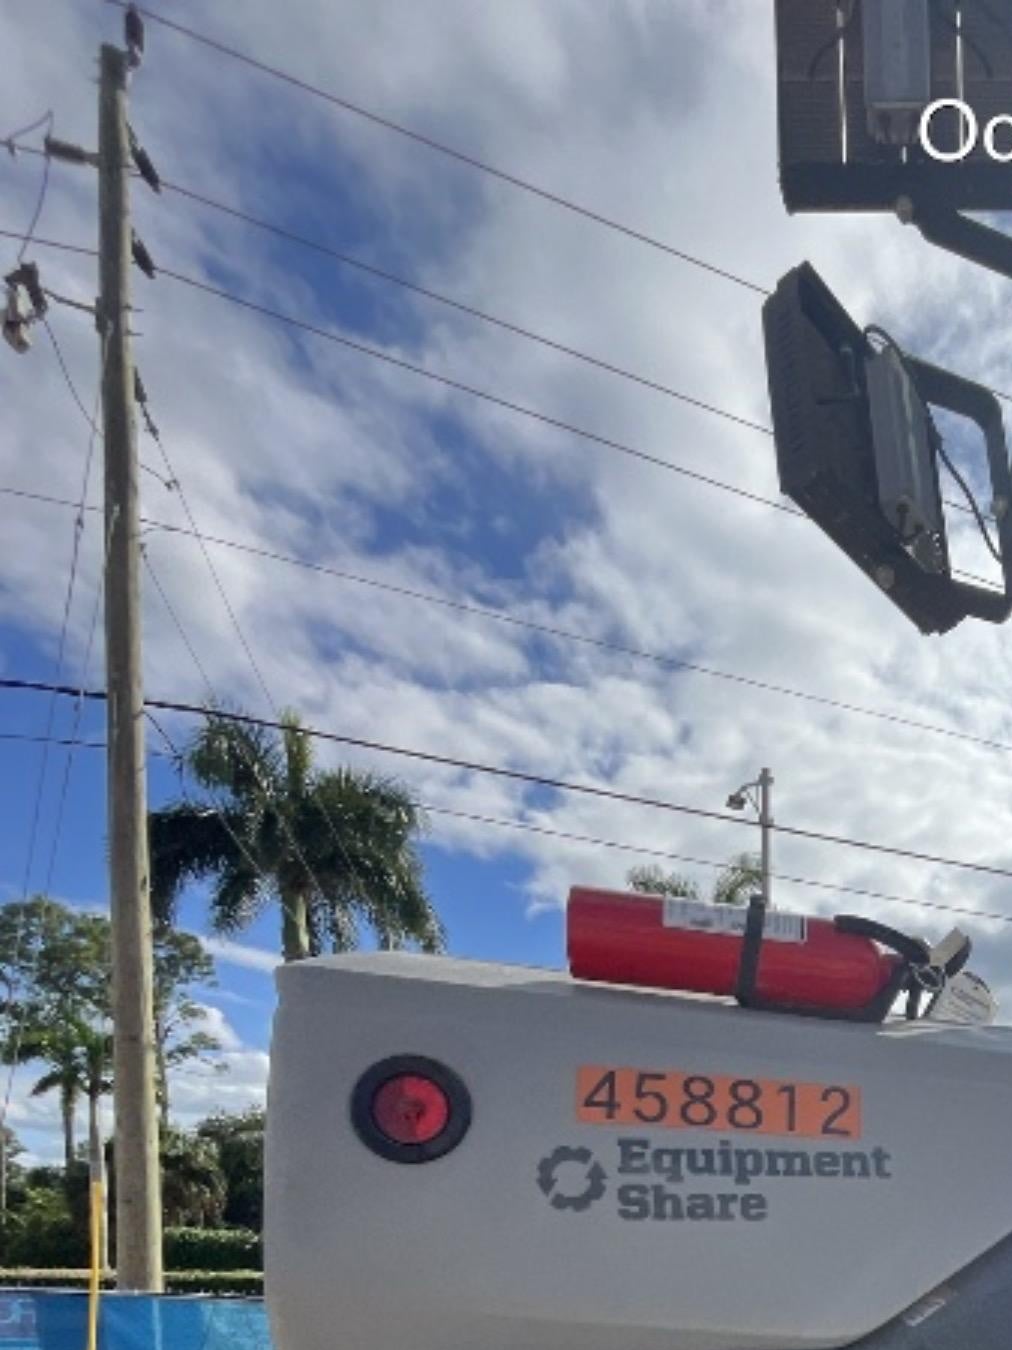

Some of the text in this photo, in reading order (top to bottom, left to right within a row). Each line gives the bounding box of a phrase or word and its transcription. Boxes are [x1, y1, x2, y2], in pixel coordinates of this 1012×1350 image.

[583, 1069, 852, 1136] 458812
[617, 1138, 892, 1185] Equipment
[617, 1184, 768, 1221] Share
